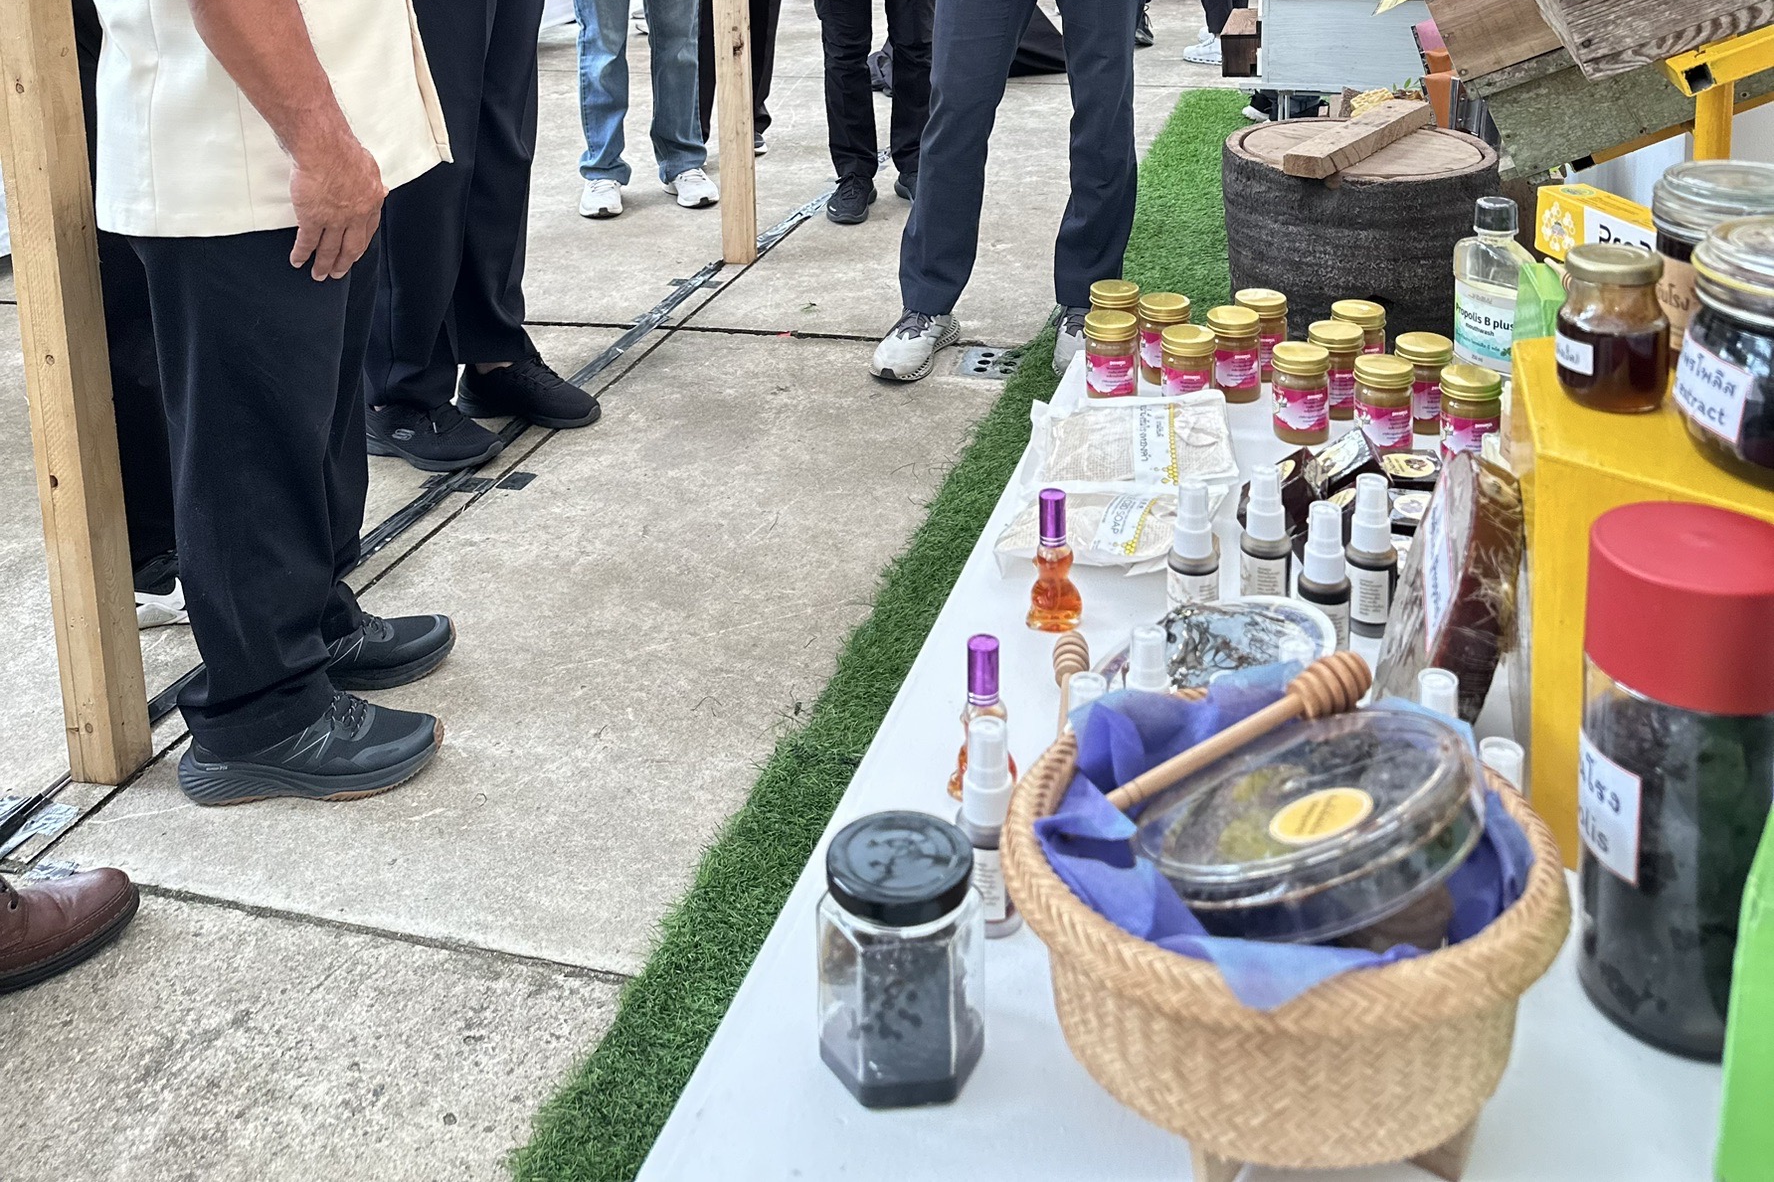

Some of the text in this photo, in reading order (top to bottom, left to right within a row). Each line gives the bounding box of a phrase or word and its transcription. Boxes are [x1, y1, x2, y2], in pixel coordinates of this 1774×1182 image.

[1456, 302, 1483, 324] Propolis
[1484, 316, 1492, 327] B
[1110, 510, 1125, 535] SOAP
[1579, 751, 1622, 815] โรง
